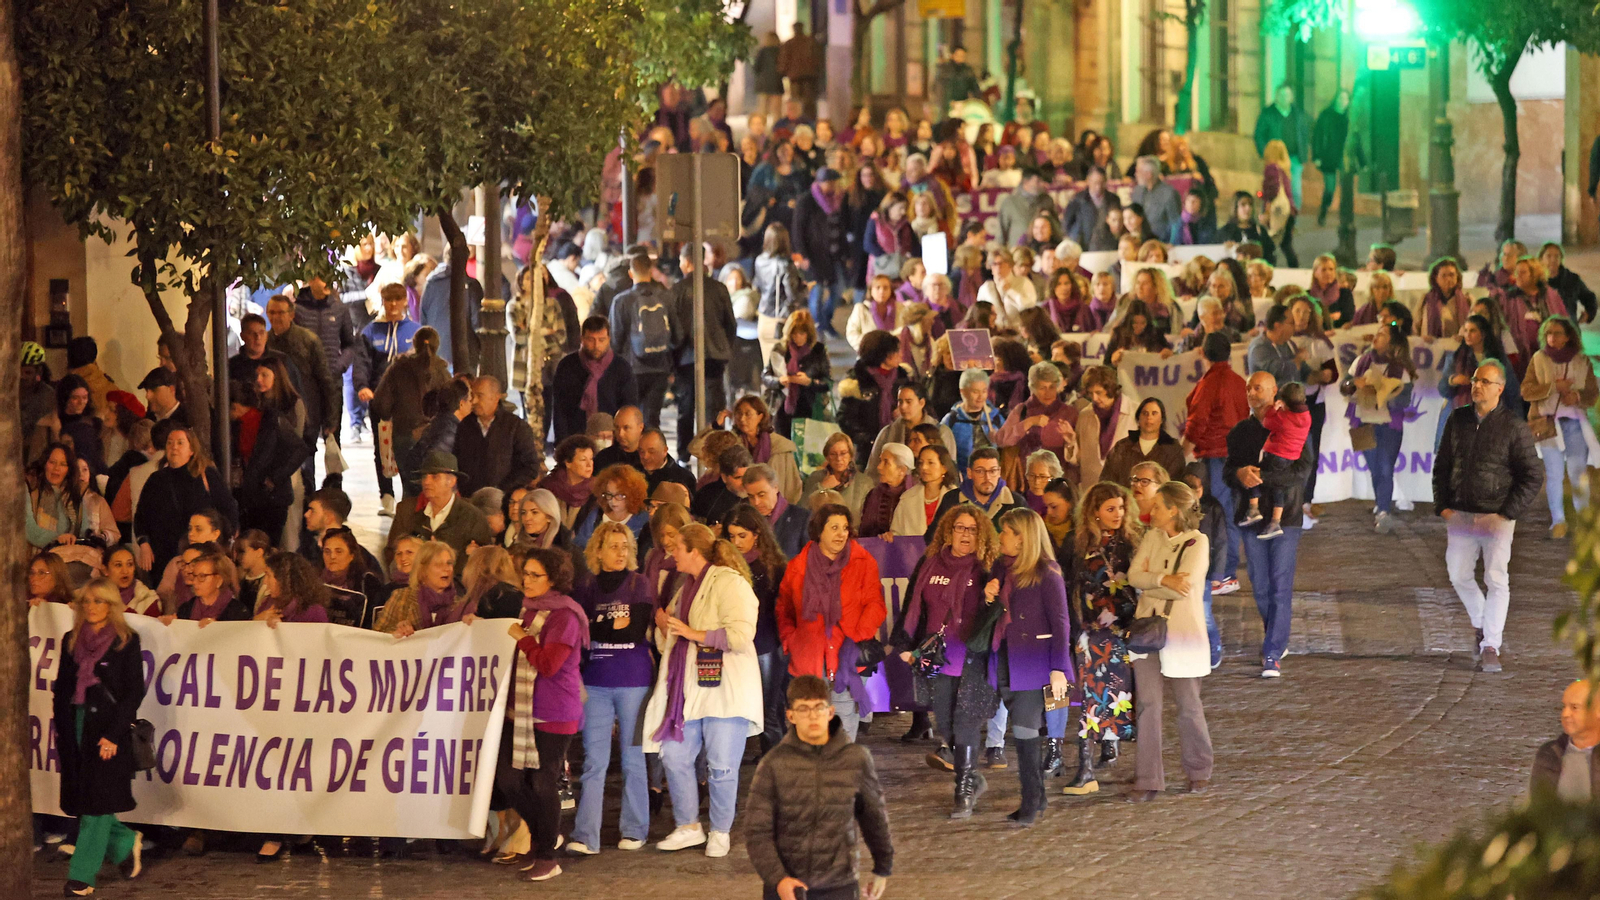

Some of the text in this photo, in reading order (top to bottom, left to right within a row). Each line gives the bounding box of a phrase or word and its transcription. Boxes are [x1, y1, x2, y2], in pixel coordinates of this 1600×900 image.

[1317, 449, 1432, 474] NACON
[235, 655, 284, 711] DE
[294, 658, 357, 714] LAS
[367, 655, 499, 714] MUJERES
[145, 729, 313, 792] OLENCIA
[327, 737, 375, 793] DE
